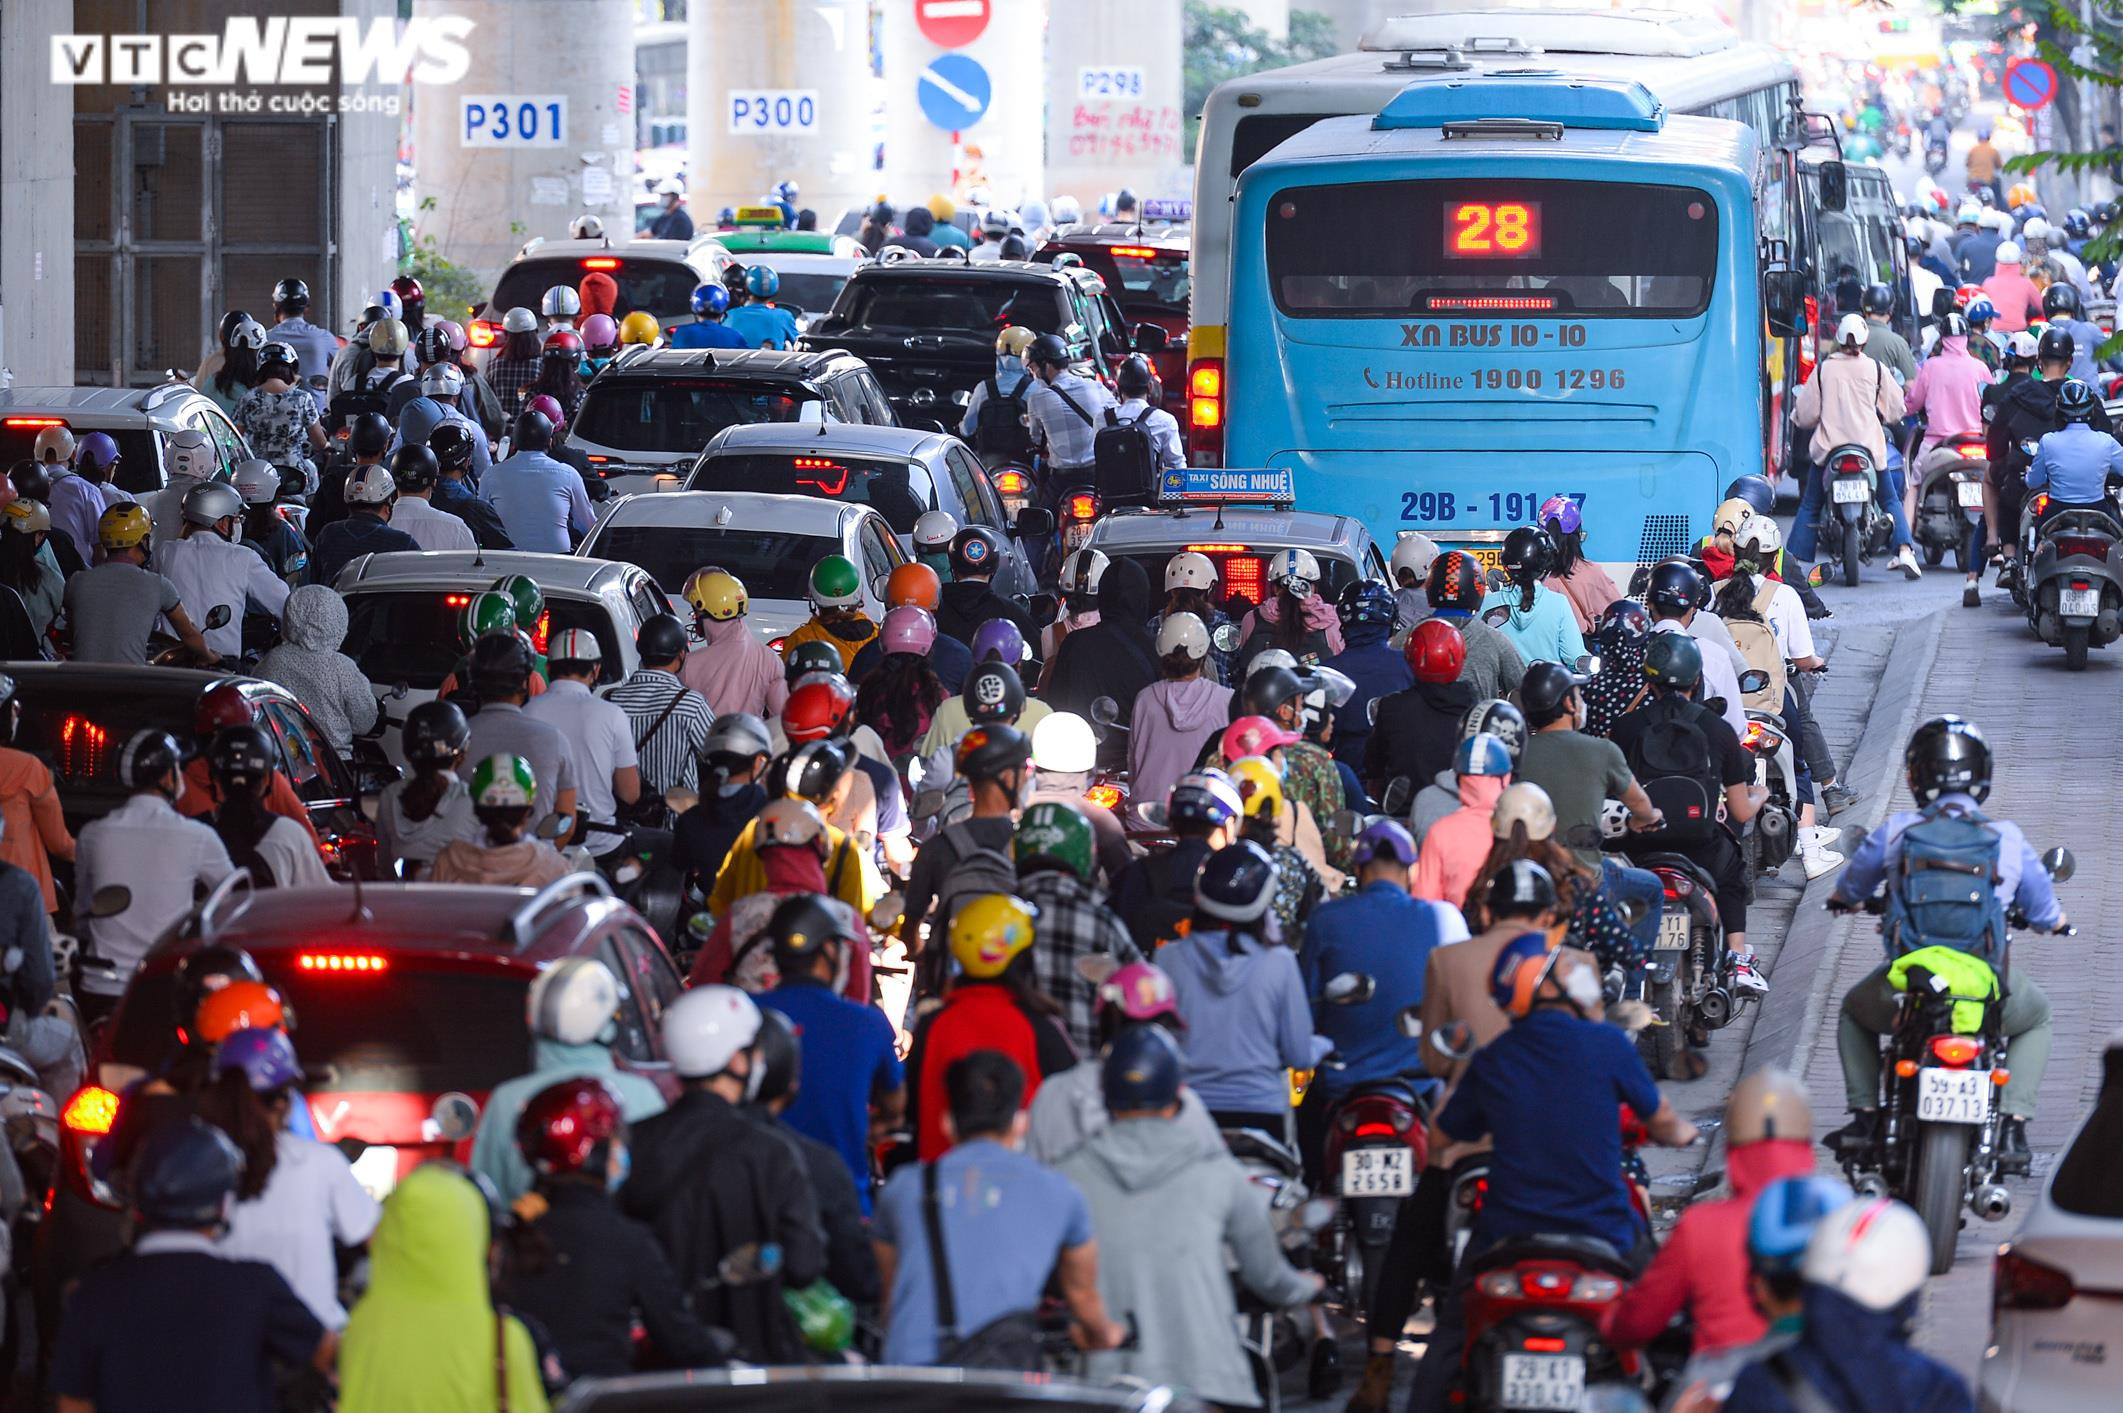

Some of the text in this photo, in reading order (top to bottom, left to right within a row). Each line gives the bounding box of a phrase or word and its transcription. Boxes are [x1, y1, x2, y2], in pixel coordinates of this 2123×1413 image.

[466, 102, 560, 140] P301
[734, 97, 813, 126] P300
[1456, 204, 1528, 249] 28
[1449, 324, 1503, 347] BUS
[1385, 369, 1625, 390] Hotline 1900 1296
[1188, 470, 1288, 494] TAXI SÔNG NHUỆ
[1400, 492, 1456, 521] 29B
